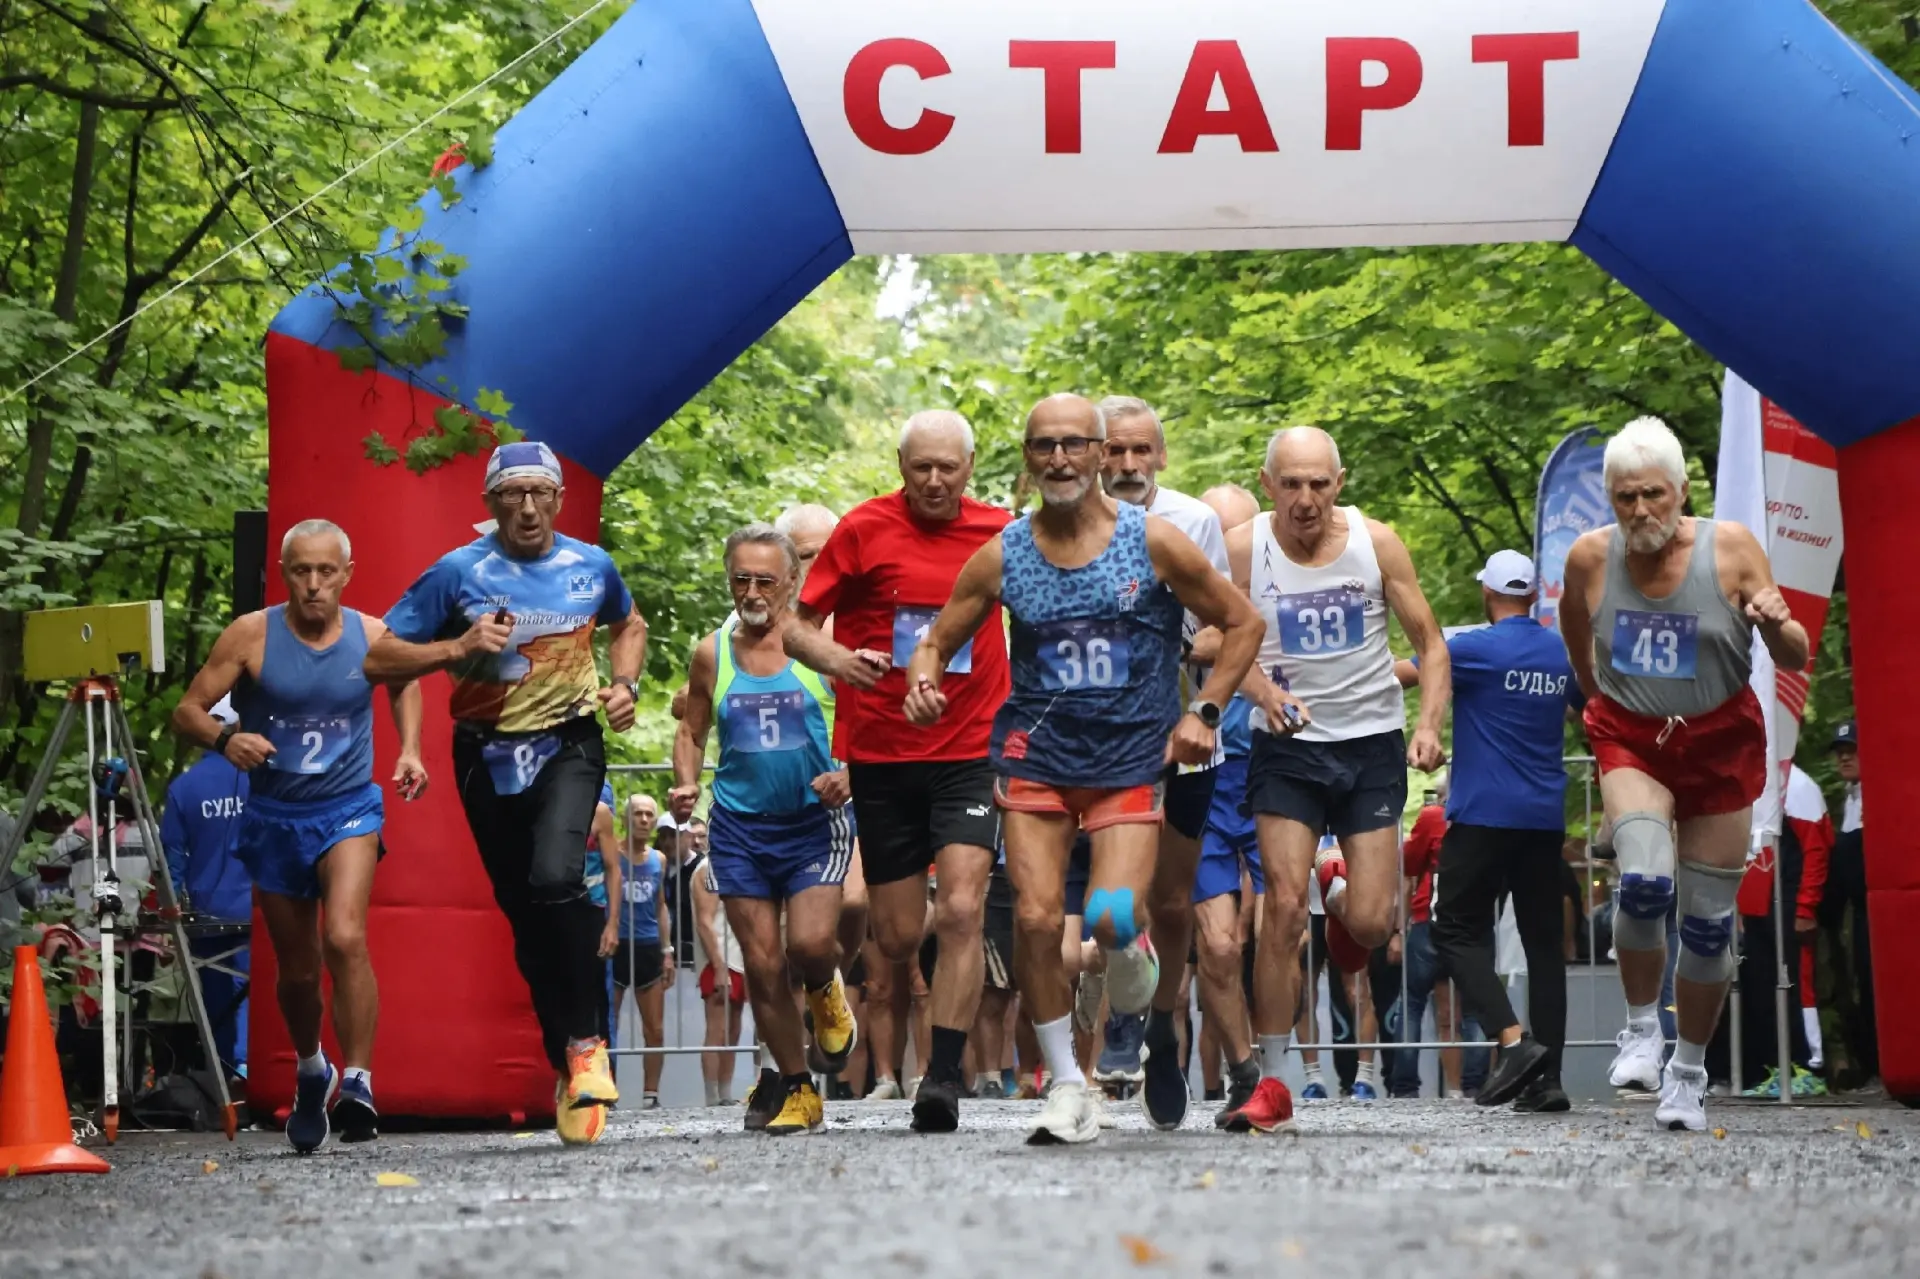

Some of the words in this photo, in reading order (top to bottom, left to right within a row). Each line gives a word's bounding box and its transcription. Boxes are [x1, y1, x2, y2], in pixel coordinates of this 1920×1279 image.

[843, 30, 1579, 156] СТАРТ
[1298, 606, 1347, 651] 33
[1057, 638, 1112, 687] 36
[1631, 628, 1678, 674] 43
[1504, 669, 1568, 696] СУДЬЯ
[759, 708, 780, 748] 5
[301, 731, 323, 770] 2
[201, 796, 244, 819] СУДЬ
